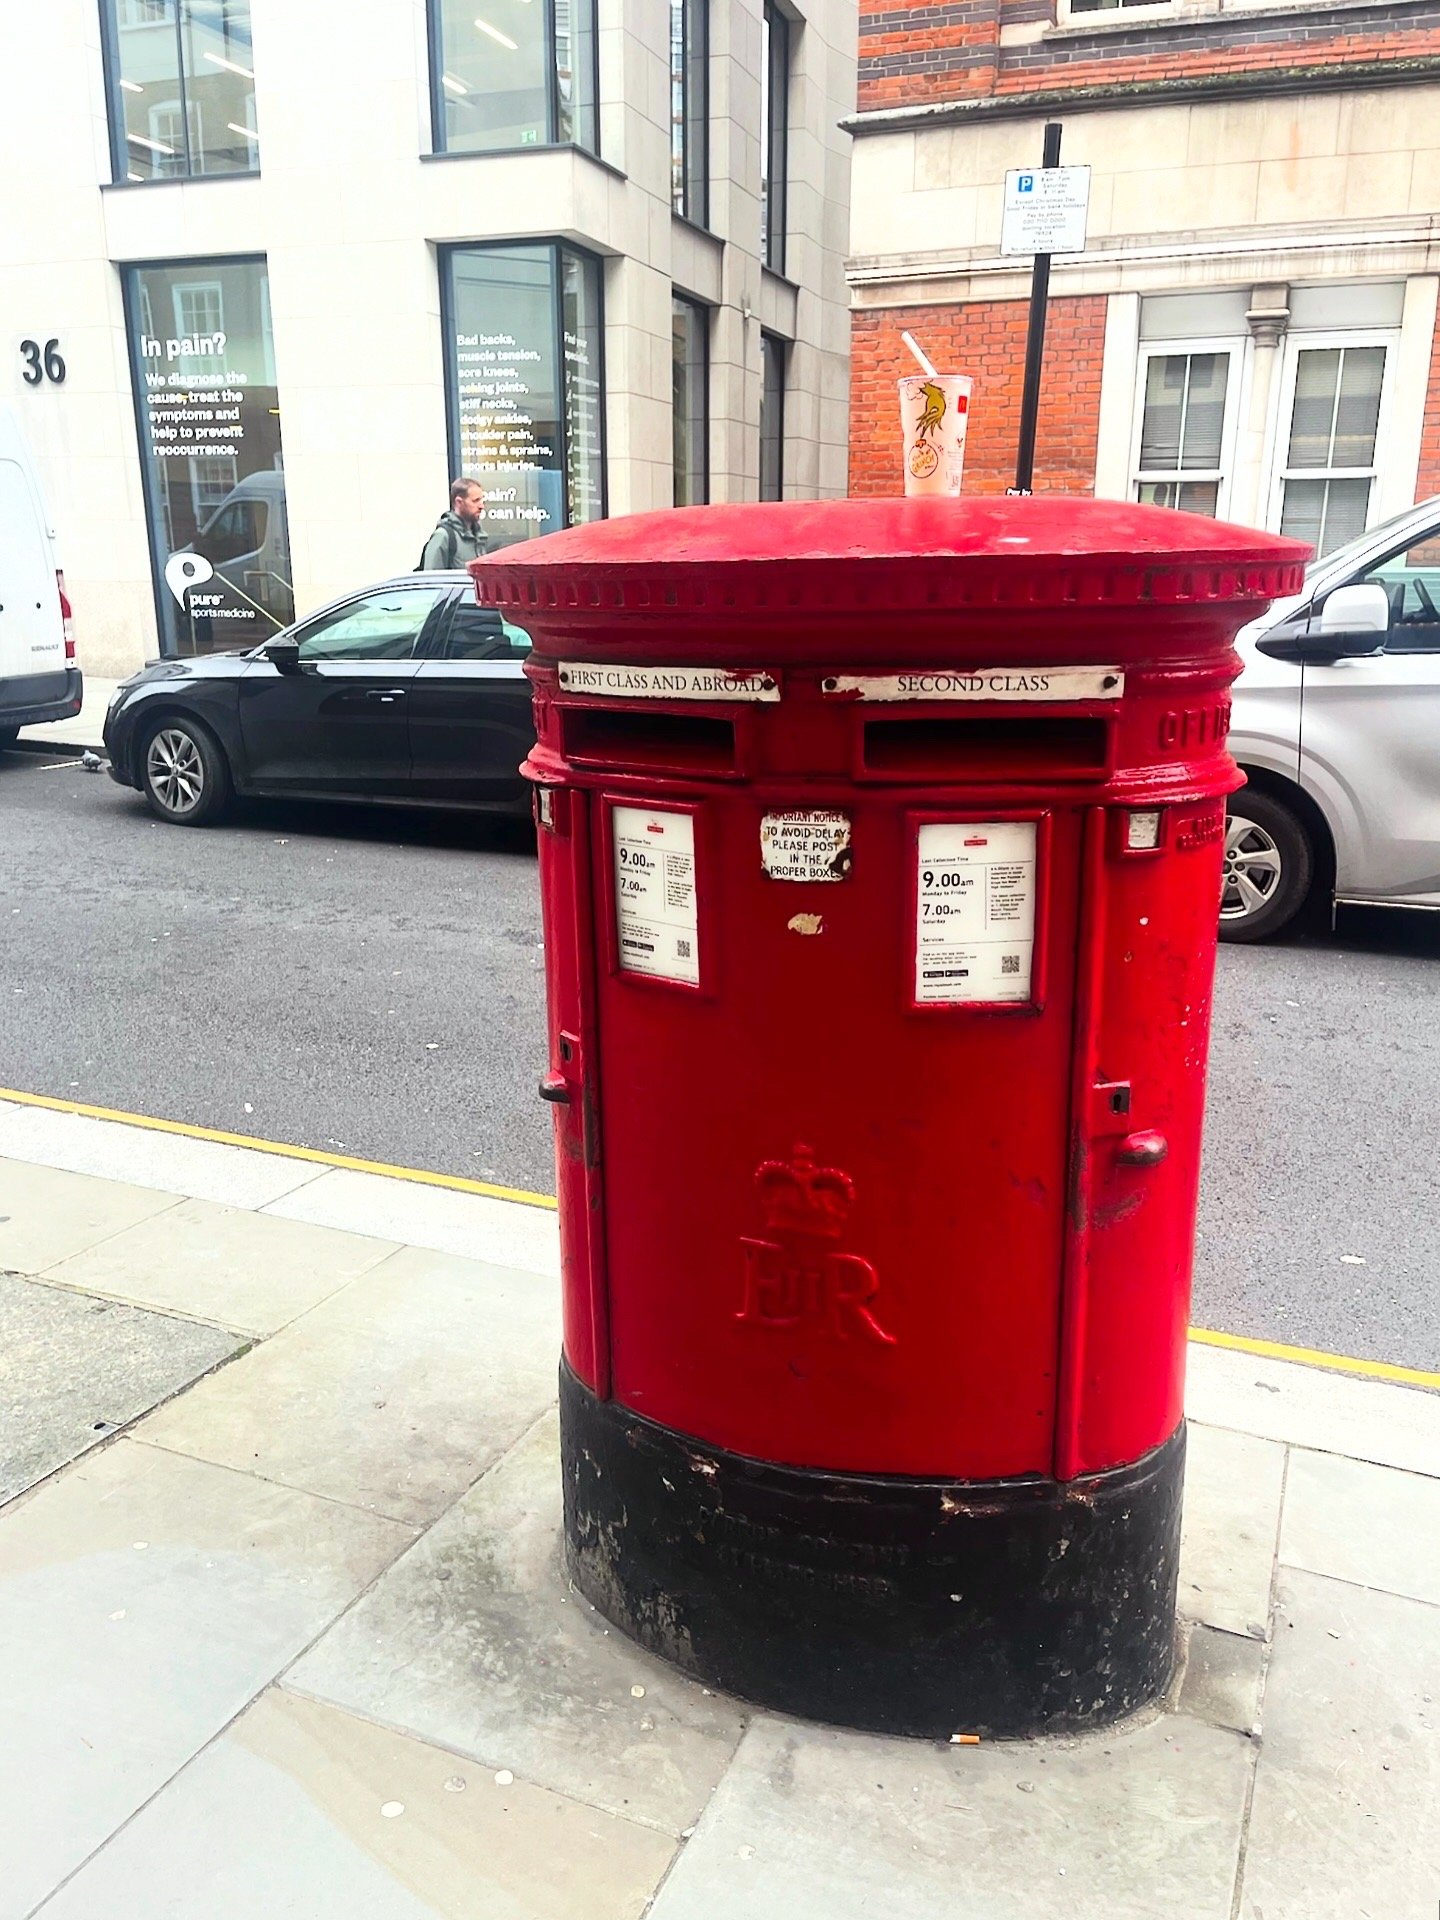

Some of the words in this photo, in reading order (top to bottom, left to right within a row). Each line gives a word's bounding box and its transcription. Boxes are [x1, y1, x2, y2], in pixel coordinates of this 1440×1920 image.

[141, 335, 161, 357] In
[166, 332, 226, 361] pain?
[456, 334, 478, 346] Bad
[20, 338, 66, 385] 36
[457, 350, 496, 362] muscle
[145, 373, 165, 386] We
[168, 372, 224, 388] diagnose
[225, 371, 247, 384] the
[188, 391, 220, 403] treat
[221, 389, 244, 402] the
[149, 409, 213, 423] symptoms
[215, 407, 240, 420] and
[150, 425, 178, 441] help
[180, 426, 193, 438] to
[195, 426, 244, 440] prevent
[499, 444, 509, 455] &
[488, 508, 514, 520] can
[516, 506, 551, 522] help.
[571, 670, 604, 686] FIRST
[606, 672, 648, 690] CLASS
[652, 675, 687, 691] AND
[691, 676, 764, 693] ABROAD
[897, 675, 984, 693] SECOND
[989, 675, 1050, 692] CLASS
[766, 826, 778, 836] TO
[781, 827, 811, 838] AVOID
[815, 829, 847, 838] DELAY
[772, 840, 808, 851] PLEASE
[813, 842, 838, 851] POST
[620, 848, 655, 868] 9.00am
[790, 854, 799, 863] IN
[803, 855, 822, 865] THE
[771, 865, 806, 877] PROPER
[620, 878, 647, 892] 7.00am
[922, 871, 974, 888] 9.00am
[922, 904, 961, 916] 7.00am
